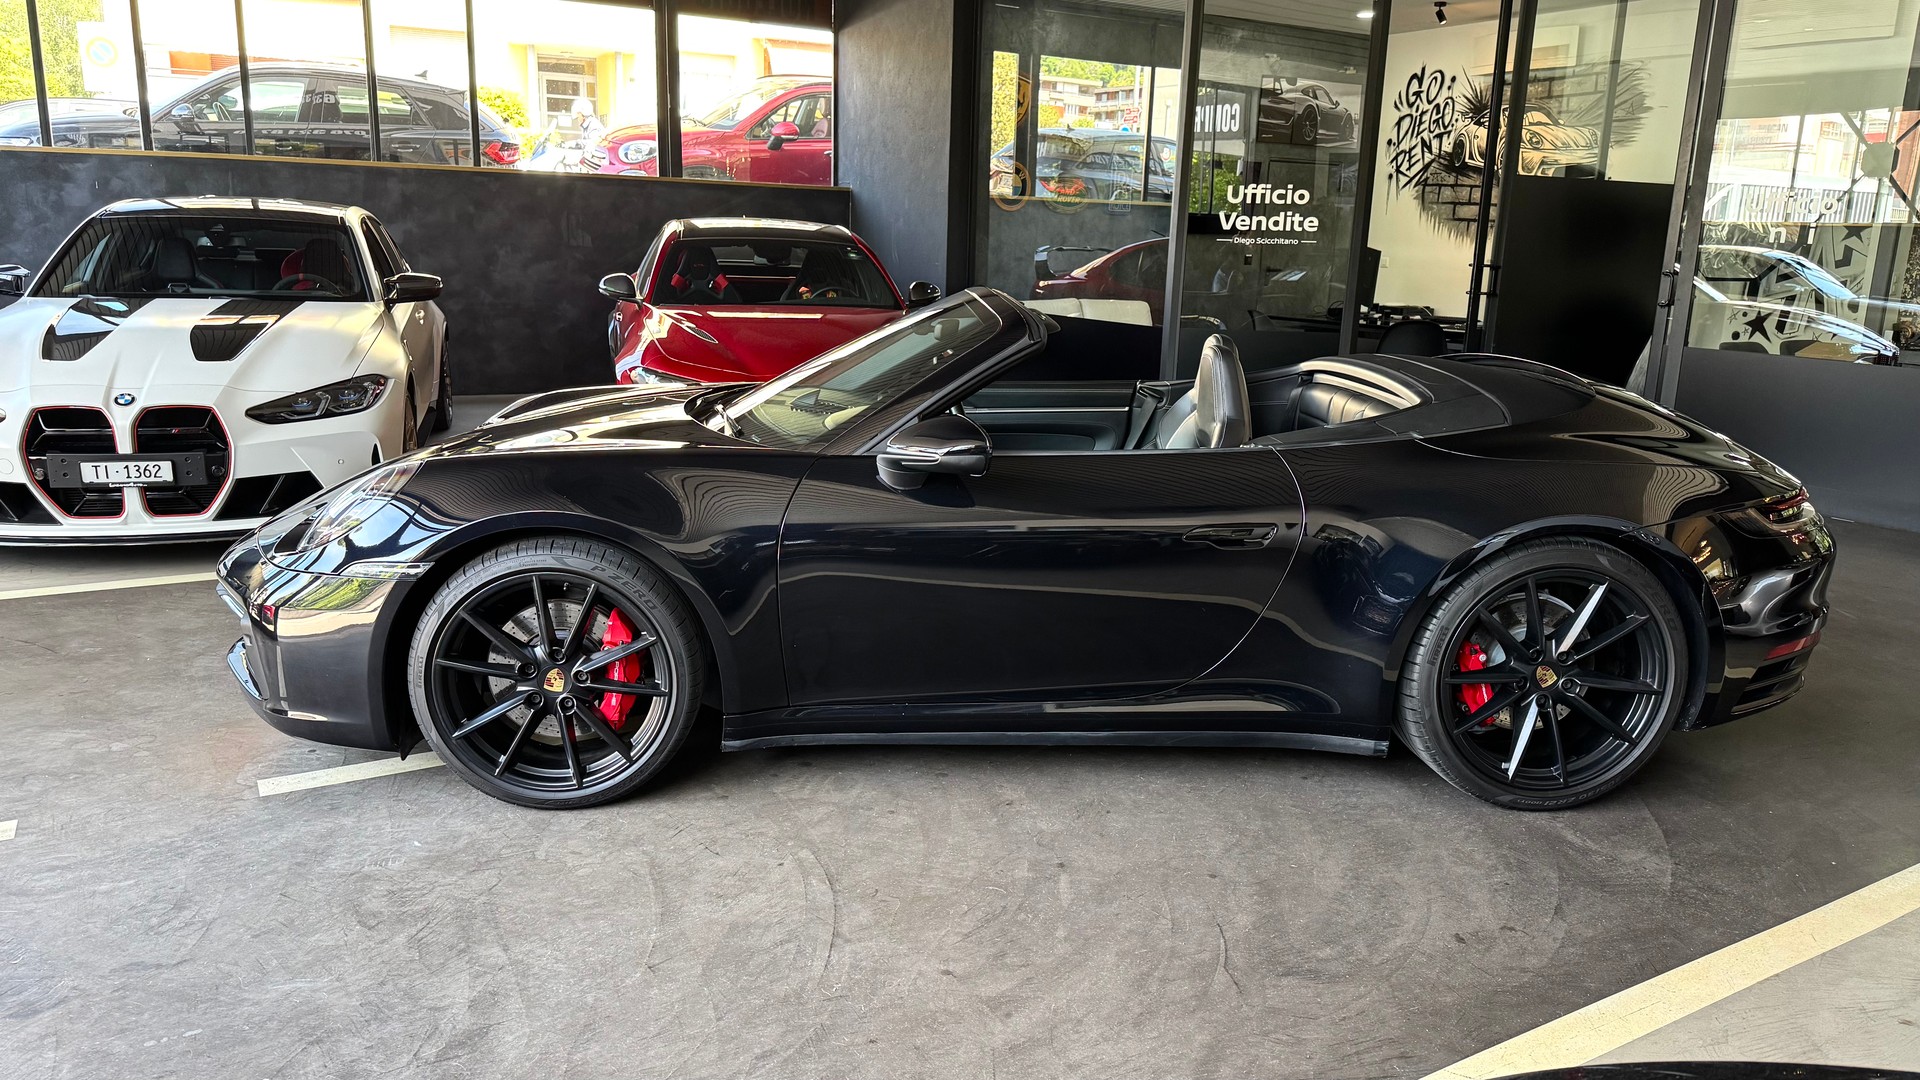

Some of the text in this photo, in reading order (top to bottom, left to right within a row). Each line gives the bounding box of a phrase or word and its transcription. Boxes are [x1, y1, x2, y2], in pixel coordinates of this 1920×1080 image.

[1405, 64, 1446, 108] GO
[1391, 97, 1455, 150] DIEGO
[1388, 130, 1453, 178] RENT
[1227, 183, 1310, 205] Ufficio
[1218, 211, 1320, 232] Vendite
[1233, 237, 1299, 246] Diego Scicchitano
[608, 572, 659, 610] ZERO
